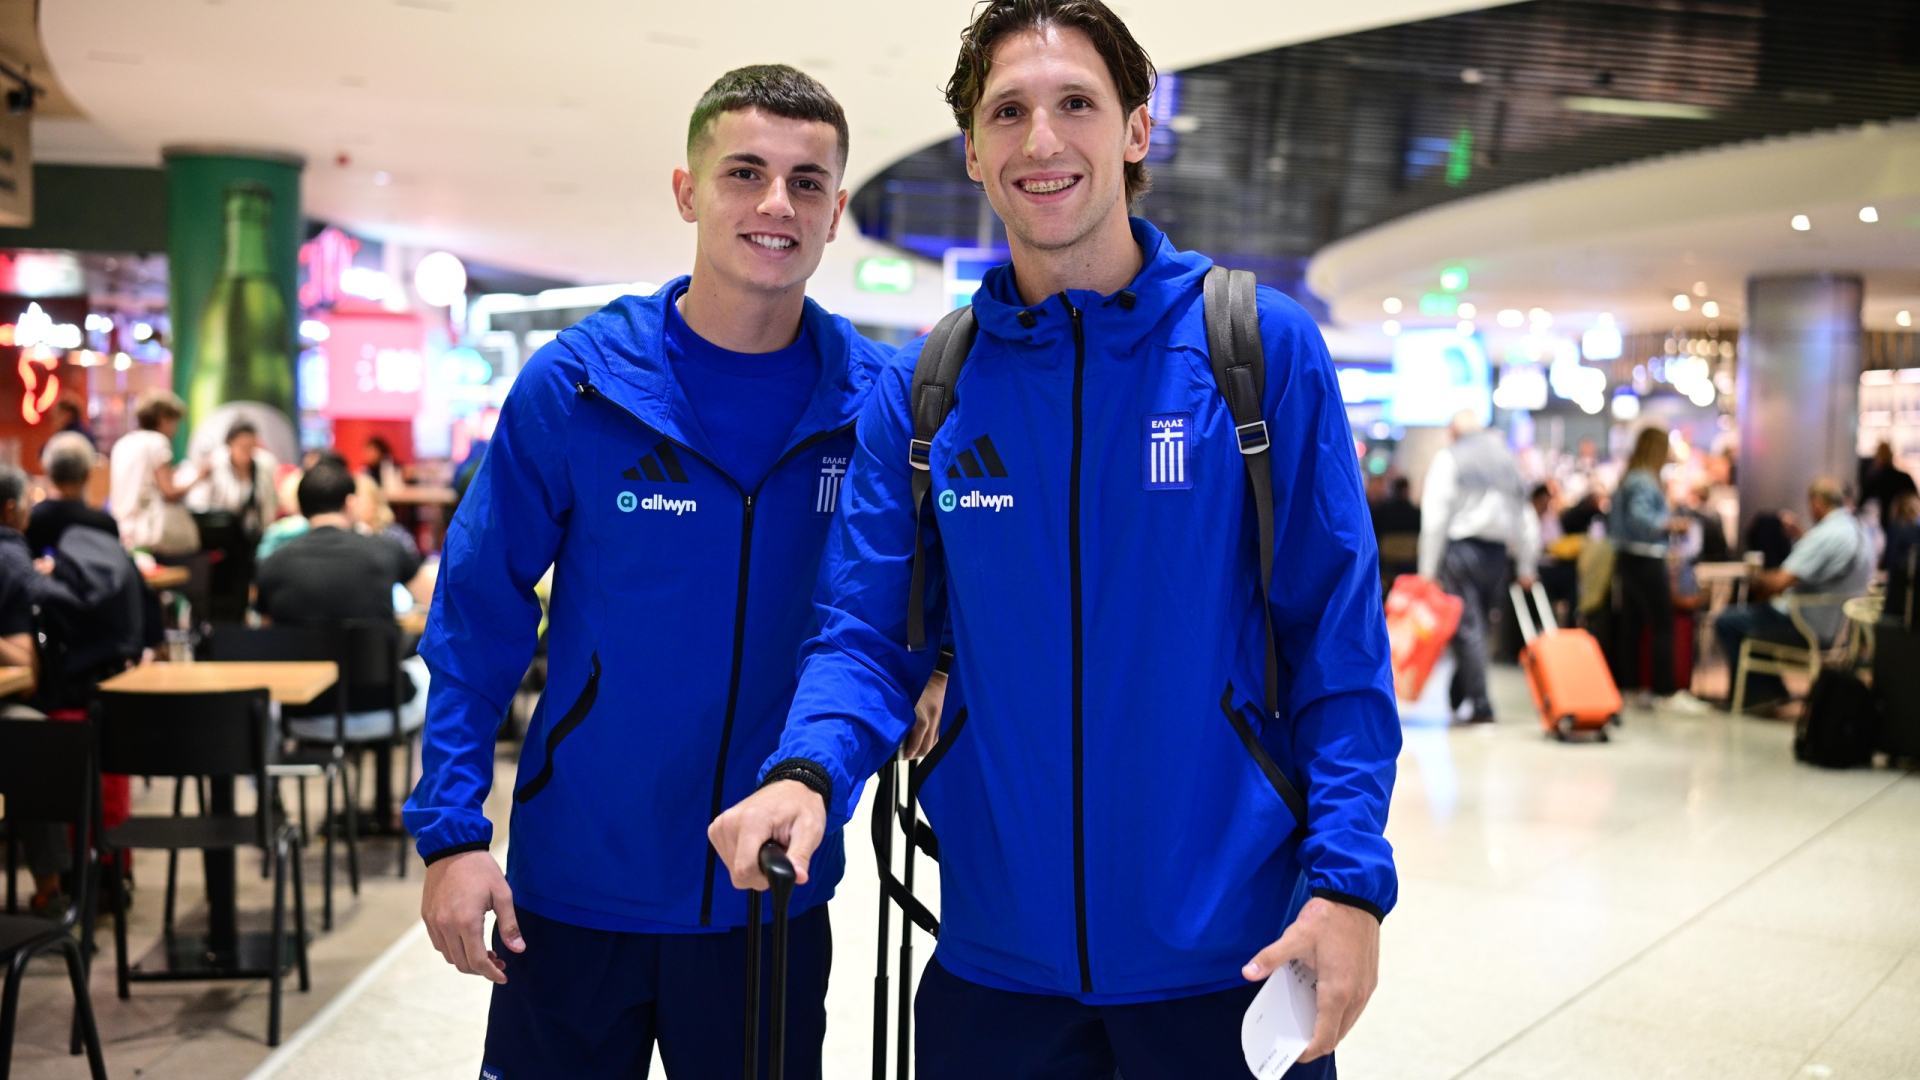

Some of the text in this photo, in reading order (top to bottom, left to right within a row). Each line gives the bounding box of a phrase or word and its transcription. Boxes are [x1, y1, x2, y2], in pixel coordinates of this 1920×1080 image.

[1151, 419, 1184, 429] ΕΛΛΑΣ
[822, 456, 847, 465] ΕΛΛΑΣ
[641, 494, 697, 516] allwyn
[960, 490, 1014, 512] allwyn
